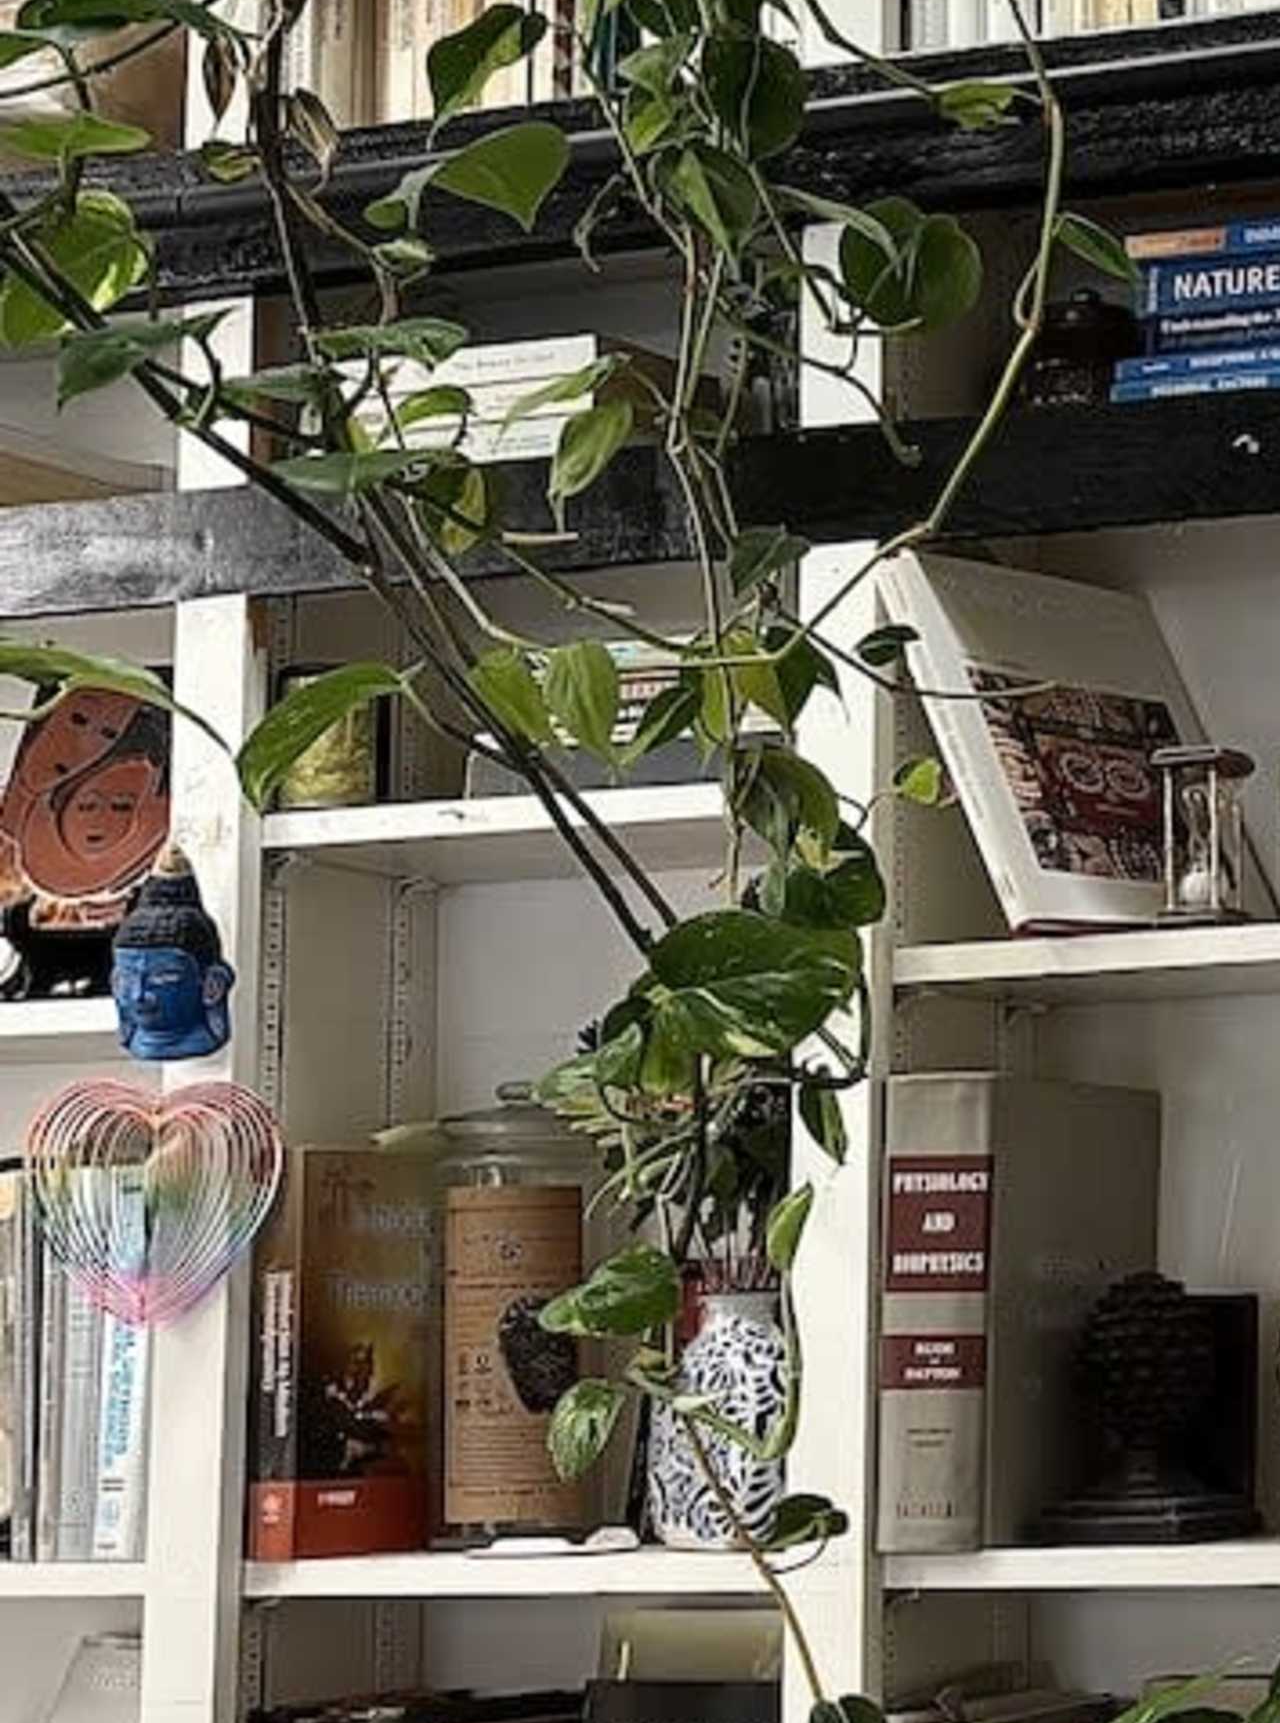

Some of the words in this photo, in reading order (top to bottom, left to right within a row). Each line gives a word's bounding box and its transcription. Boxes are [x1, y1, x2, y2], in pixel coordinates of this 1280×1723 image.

[892, 1172, 989, 1193] PHYSIOLOGY
[922, 1212, 956, 1232] AND
[892, 1252, 984, 1274] BIOPHYSICS
